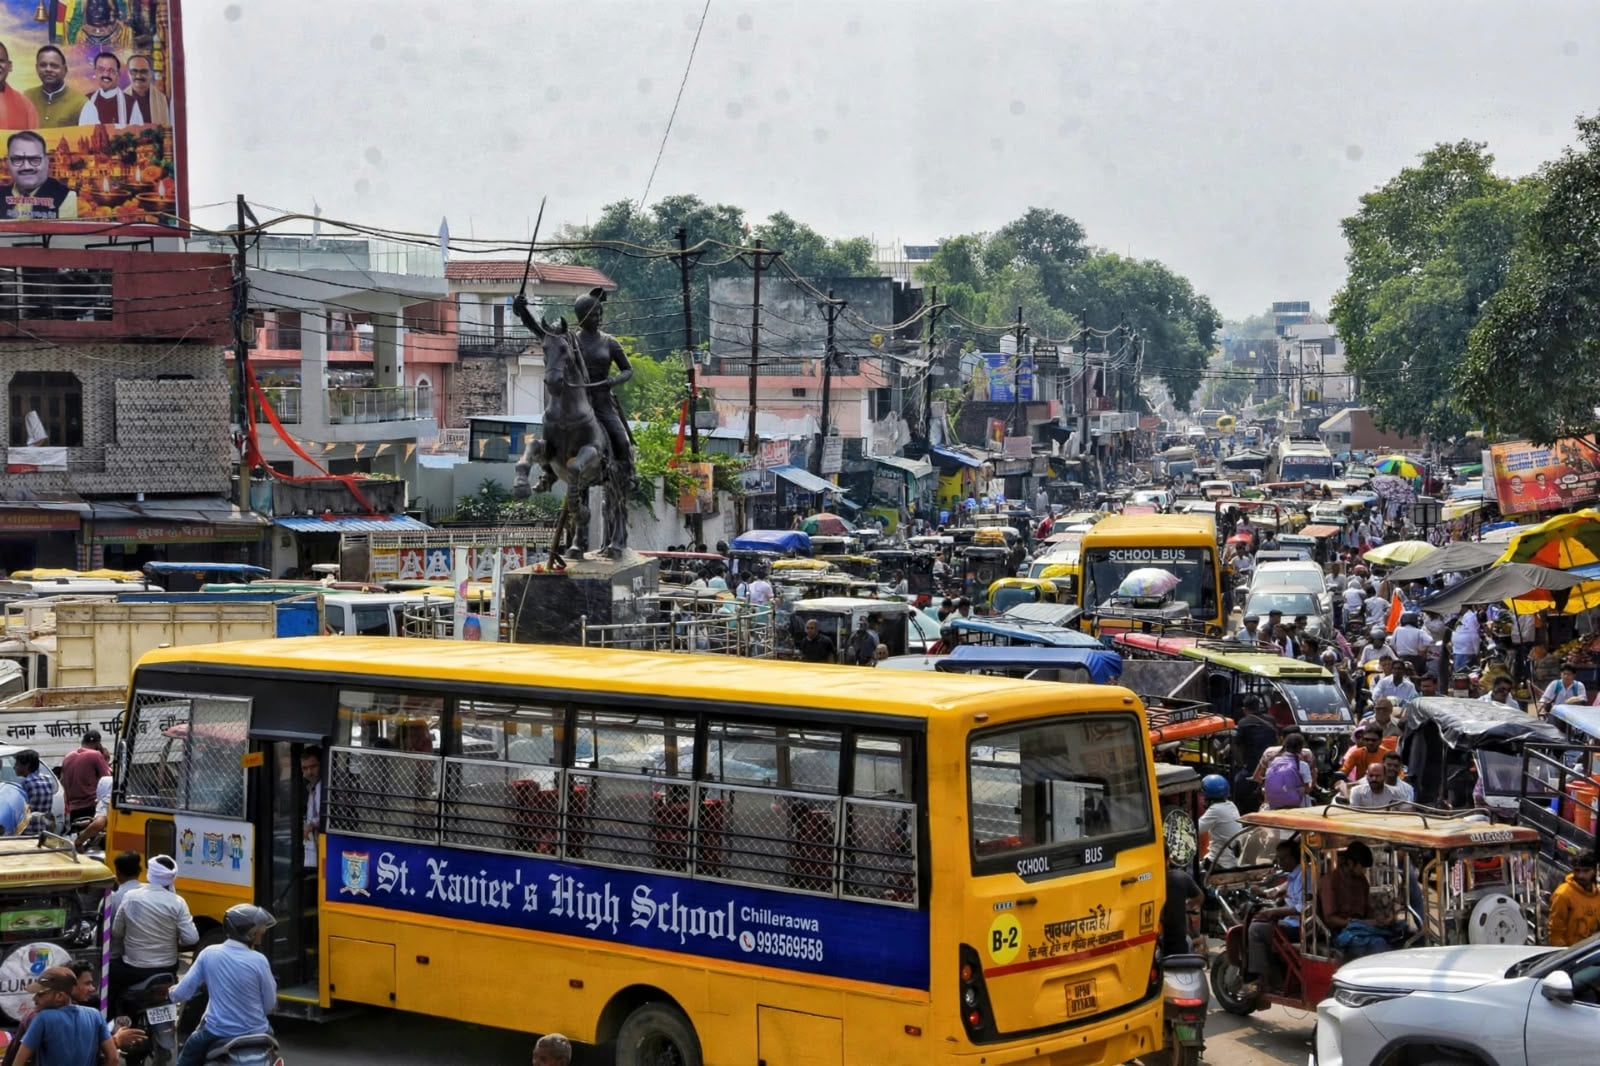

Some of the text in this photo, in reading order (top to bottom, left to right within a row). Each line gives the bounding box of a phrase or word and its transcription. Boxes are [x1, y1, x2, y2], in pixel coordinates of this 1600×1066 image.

[1108, 549, 1186, 561] SCHOOL BUS
[1016, 846, 1103, 876] SCHOOL BUS
[376, 852, 737, 944] St. Xavier's High School
[757, 930, 823, 962] 993569558
[992, 926, 1018, 953] B-2
